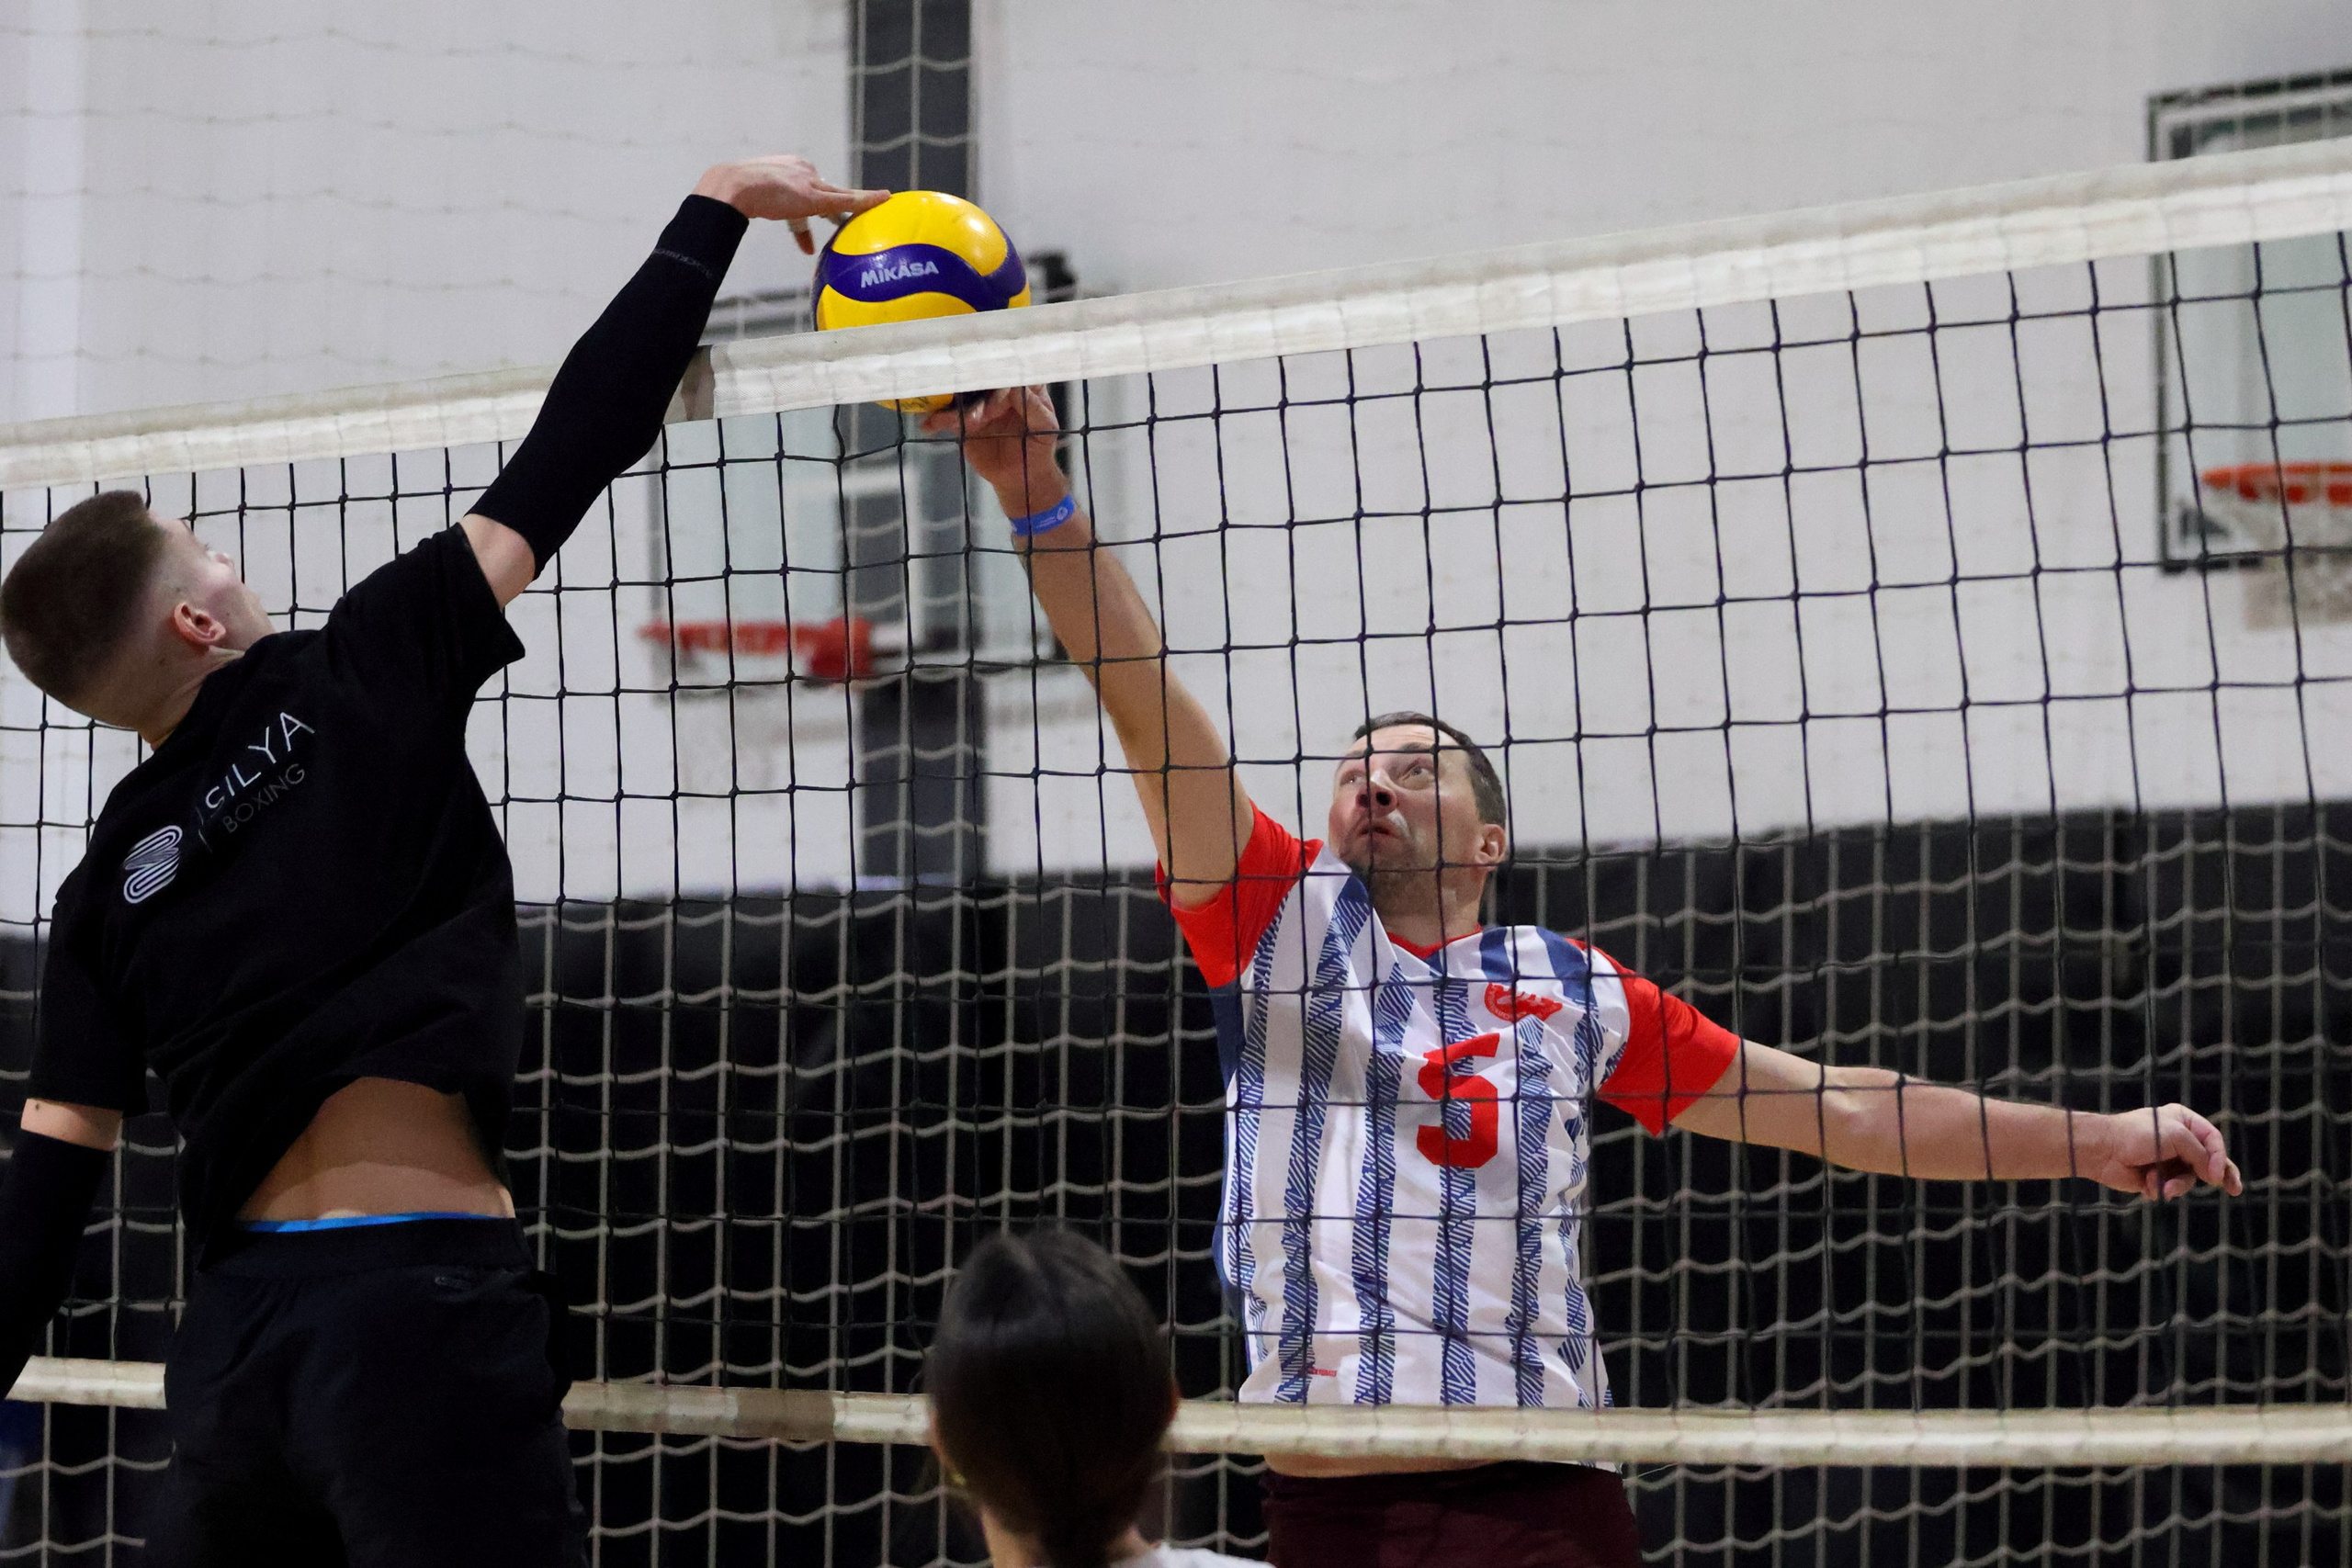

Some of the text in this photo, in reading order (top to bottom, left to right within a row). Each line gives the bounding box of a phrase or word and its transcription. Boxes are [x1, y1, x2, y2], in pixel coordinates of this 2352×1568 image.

[861, 261, 939, 288] MIKASA
[223, 763, 305, 832] BOXING
[1417, 1032, 1500, 1168] 5
